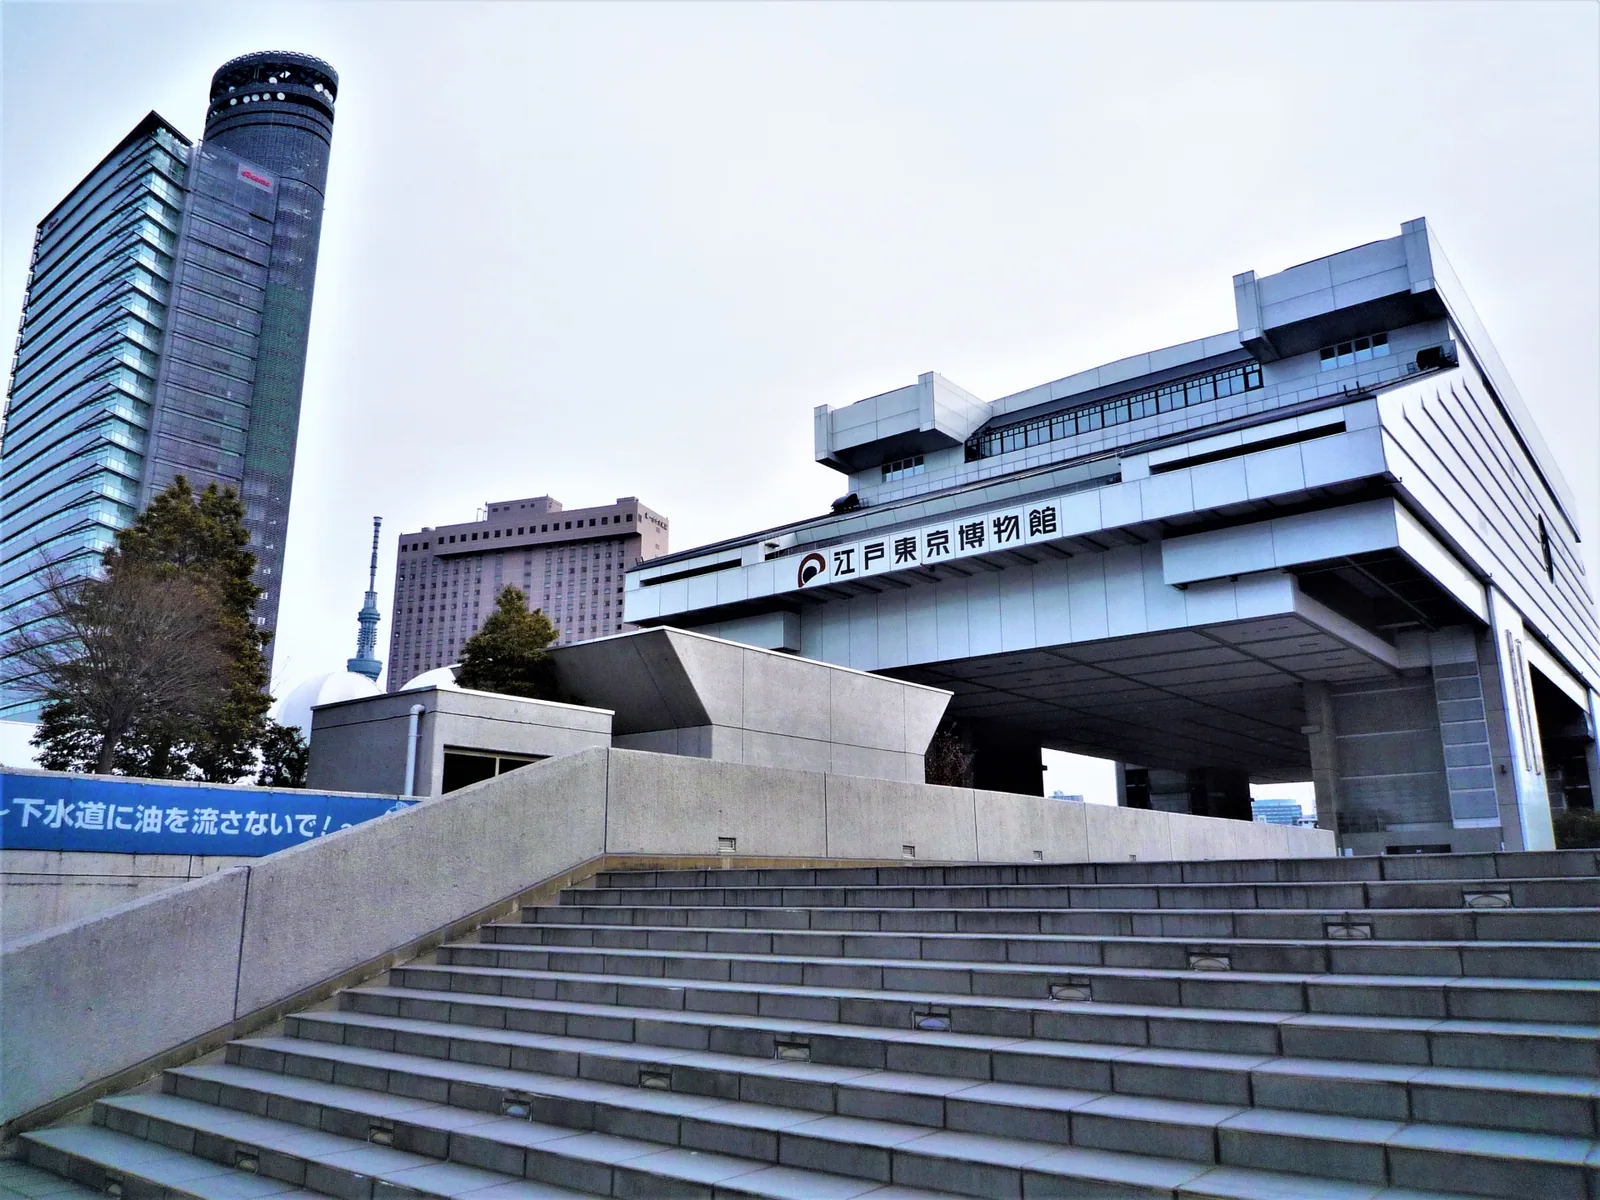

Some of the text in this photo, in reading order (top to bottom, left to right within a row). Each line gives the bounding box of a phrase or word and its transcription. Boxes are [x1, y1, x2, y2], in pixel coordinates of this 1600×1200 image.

[834, 506, 1057, 576] 江戸東京博物館
